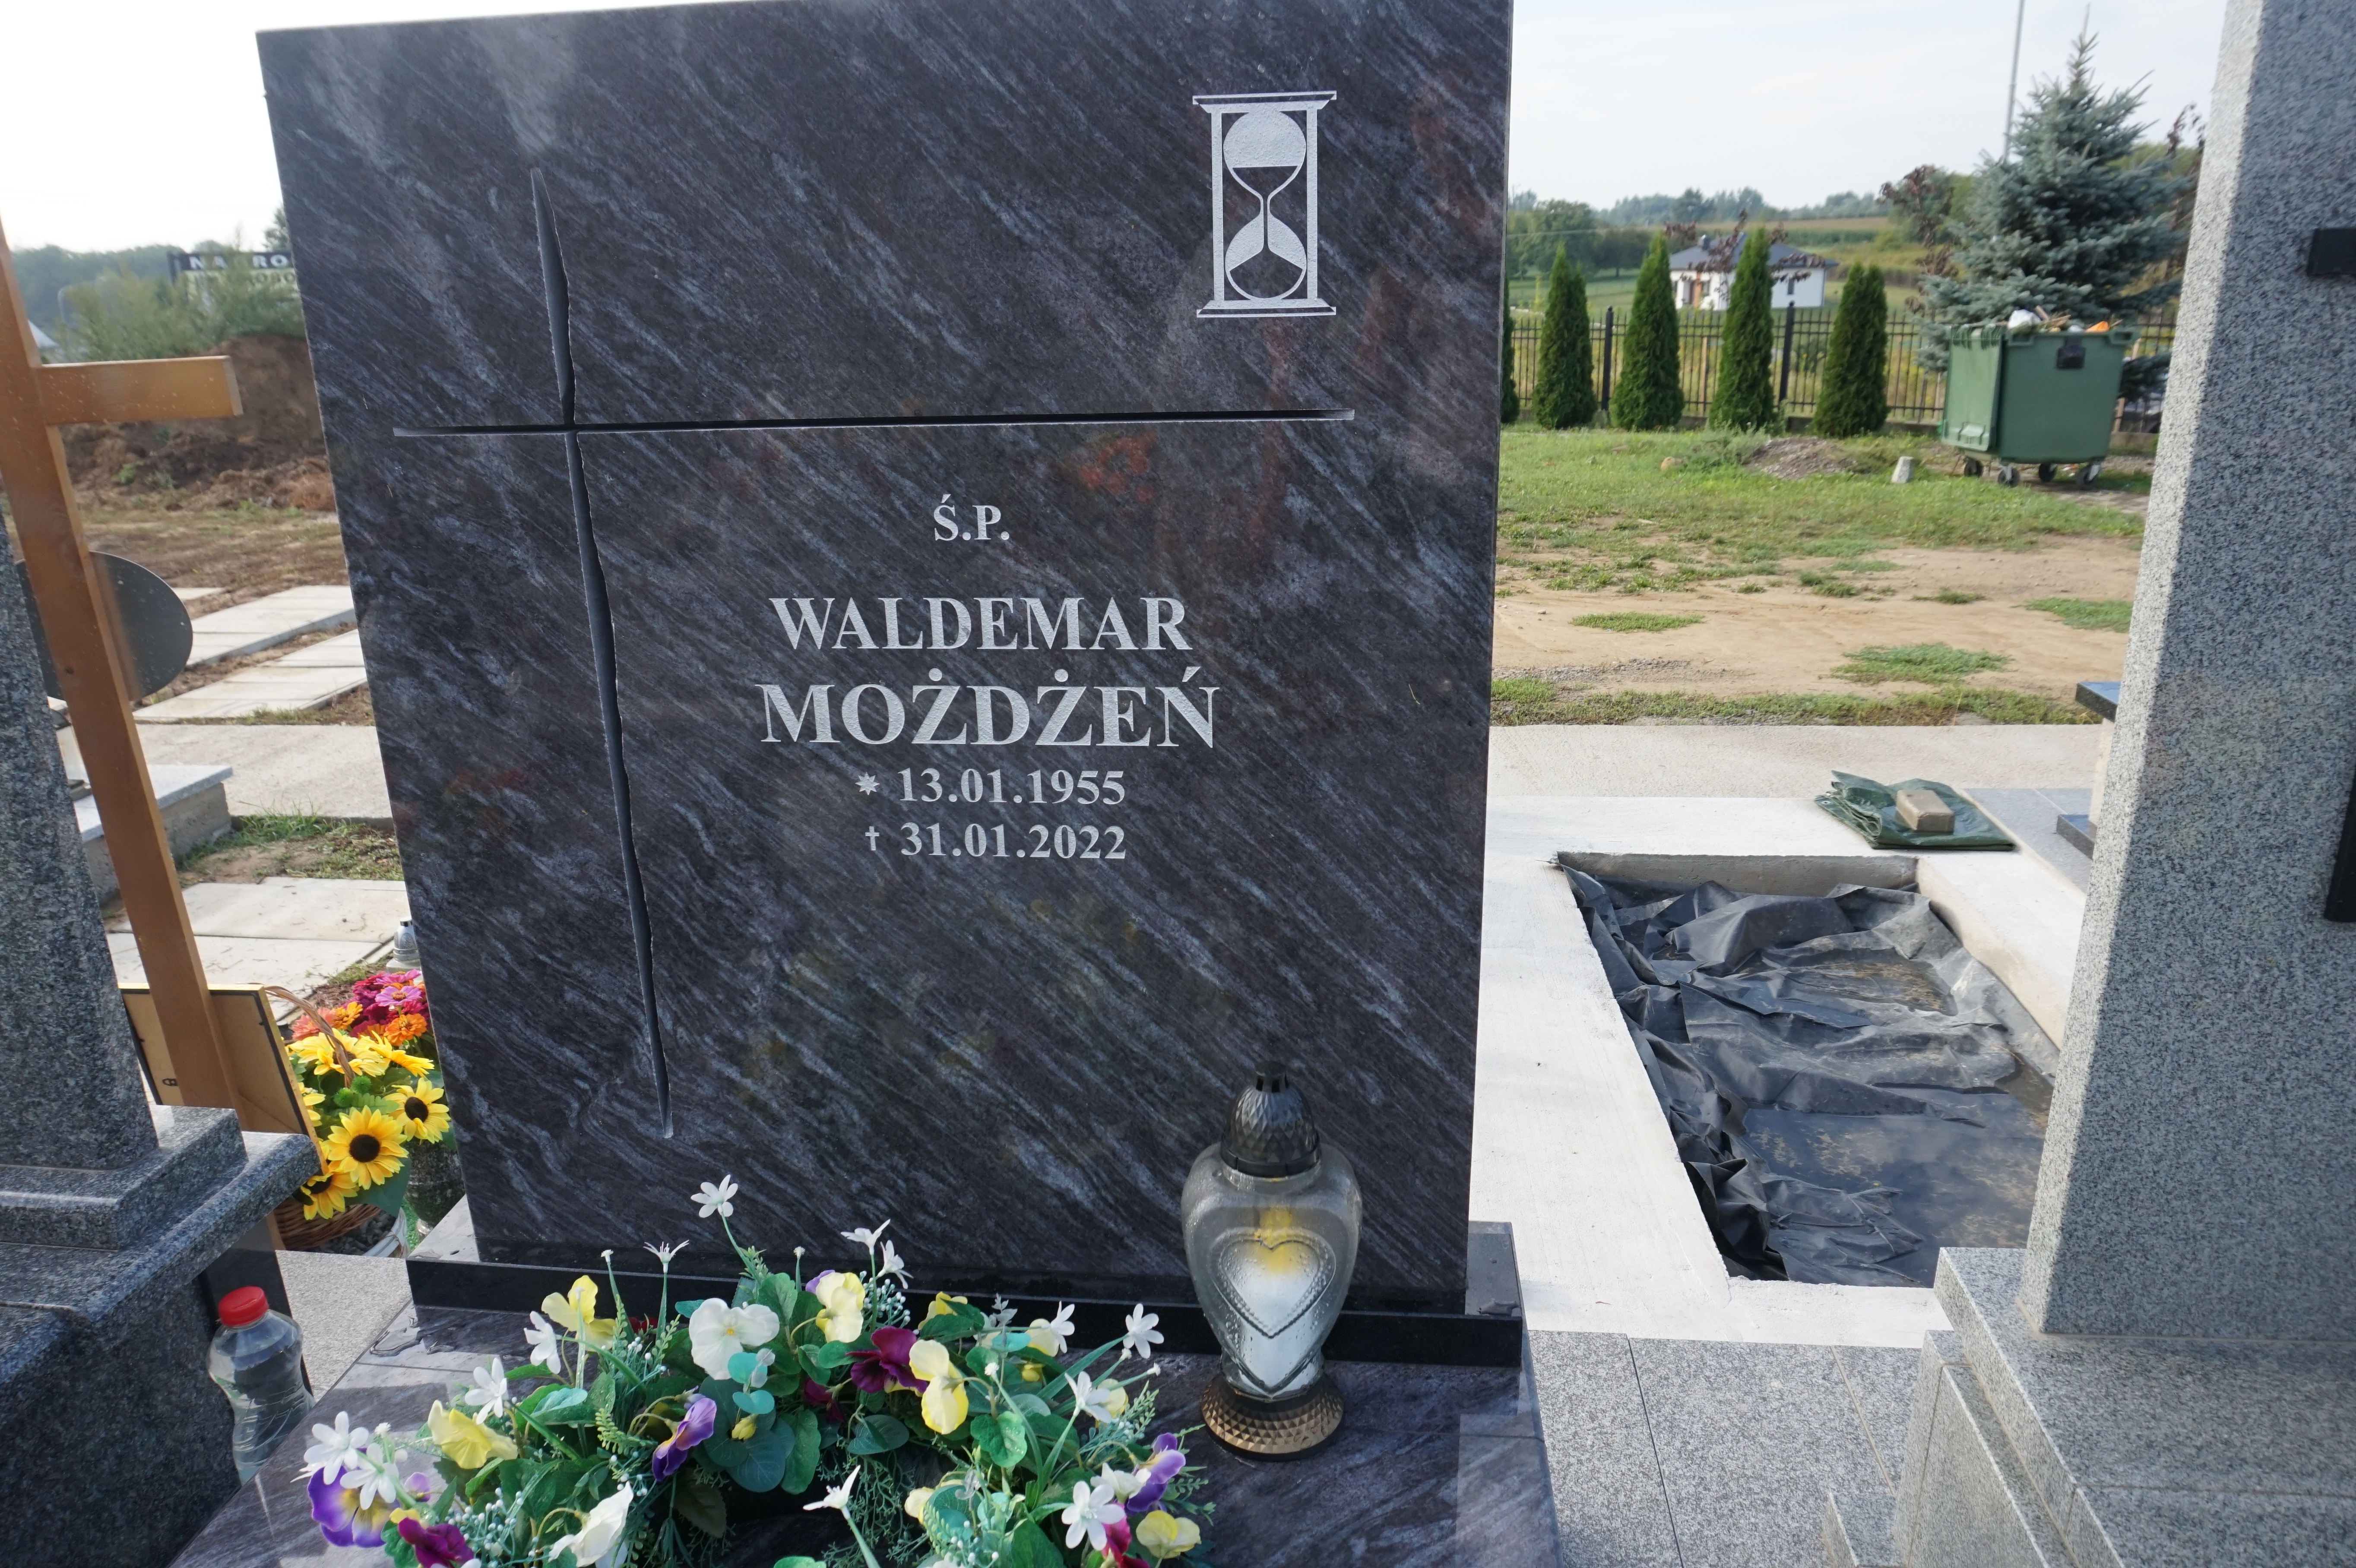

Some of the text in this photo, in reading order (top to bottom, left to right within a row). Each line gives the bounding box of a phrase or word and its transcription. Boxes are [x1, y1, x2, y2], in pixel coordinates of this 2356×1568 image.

[189, 254, 289, 269] NARO
[933, 493, 1010, 541] Ś.P.
[768, 596, 1194, 650] WALDEMAR
[754, 666, 1220, 749] MOŻDŻEŃ
[897, 767, 1126, 805] 13.01.1955
[900, 822, 1127, 860] 31.01.2022
